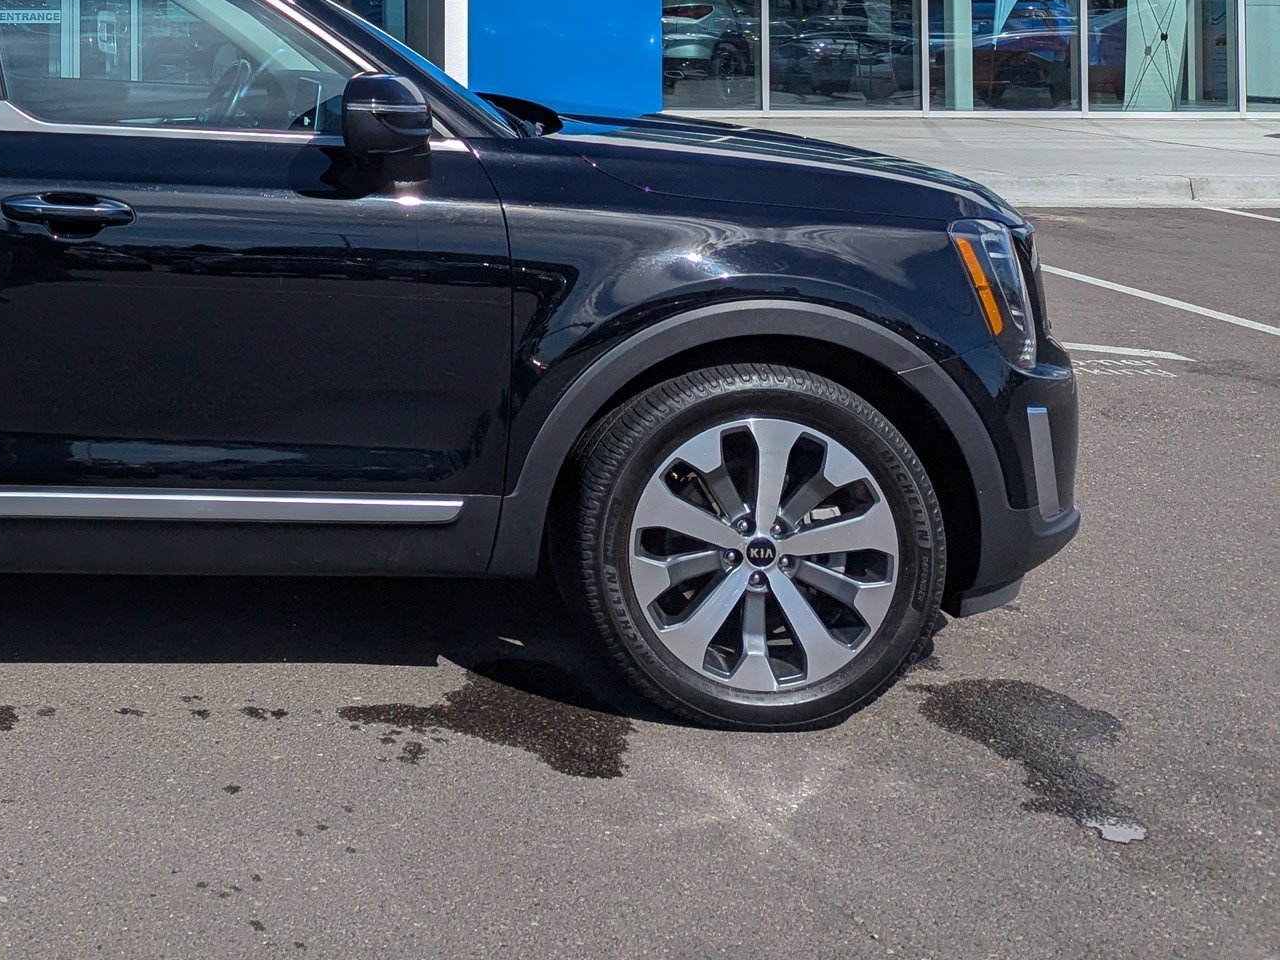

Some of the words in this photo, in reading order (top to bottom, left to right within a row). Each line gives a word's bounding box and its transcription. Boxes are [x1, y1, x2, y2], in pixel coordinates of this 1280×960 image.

[0, 12, 60, 21] ENTRANCE
[879, 448, 930, 544] MICHELIN
[750, 547, 774, 558] KIA
[917, 555, 930, 602] DEFENDER
[605, 570, 655, 665] MICHELIN
